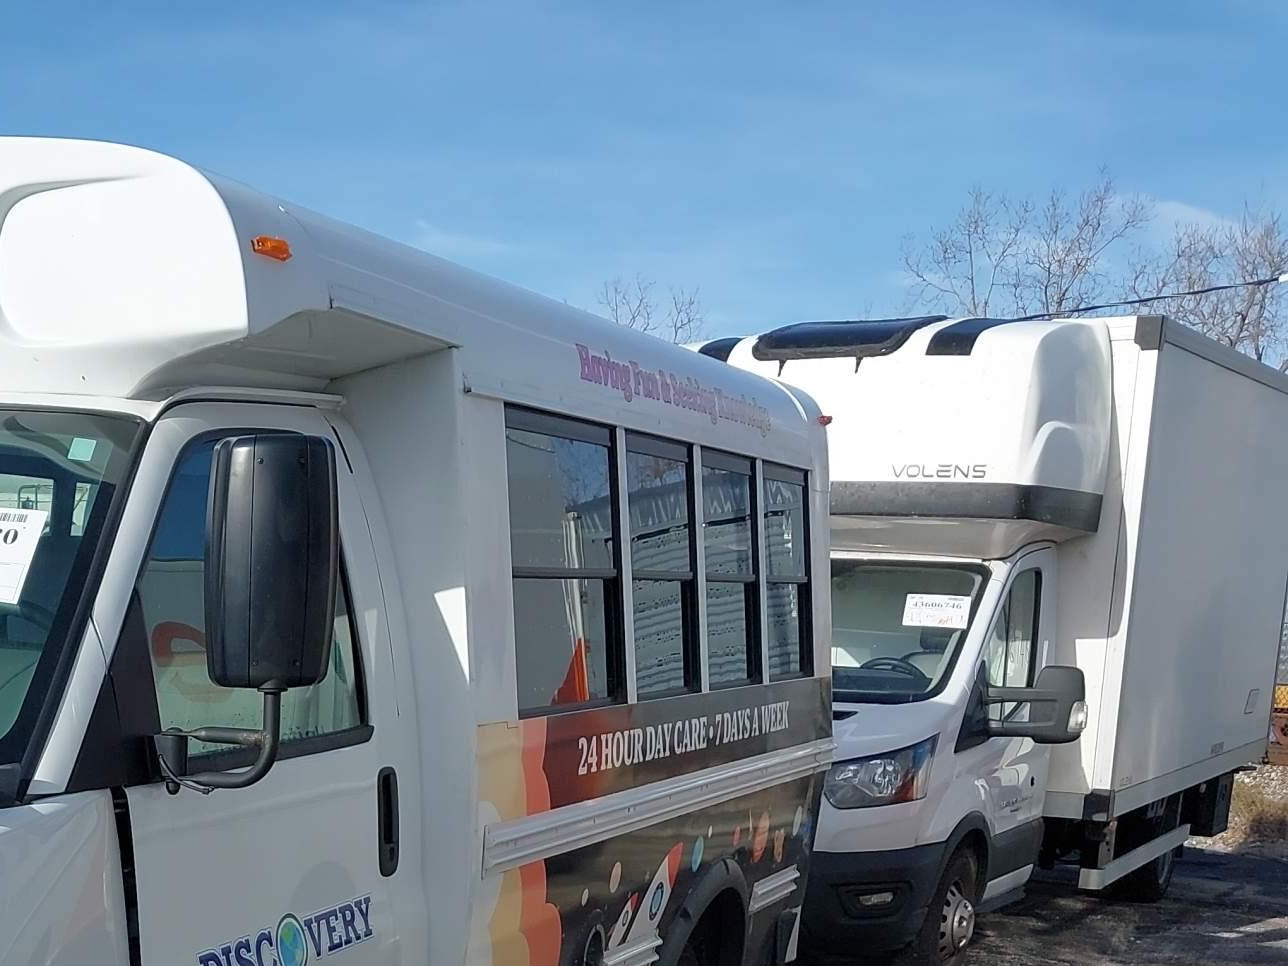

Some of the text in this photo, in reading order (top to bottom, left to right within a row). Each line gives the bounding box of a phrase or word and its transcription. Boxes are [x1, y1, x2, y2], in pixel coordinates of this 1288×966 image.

[575, 343, 633, 403] Having
[630, 359, 661, 401] Fun
[891, 463, 987, 479] VOLENS
[578, 735, 597, 775] 24
[600, 727, 643, 770] HOUR
[645, 722, 672, 760] DAY
[674, 716, 708, 755] CARE
[715, 713, 722, 746] 7
[723, 707, 751, 744] DAYS
[751, 707, 760, 737] A
[761, 701, 790, 733] WEEK
